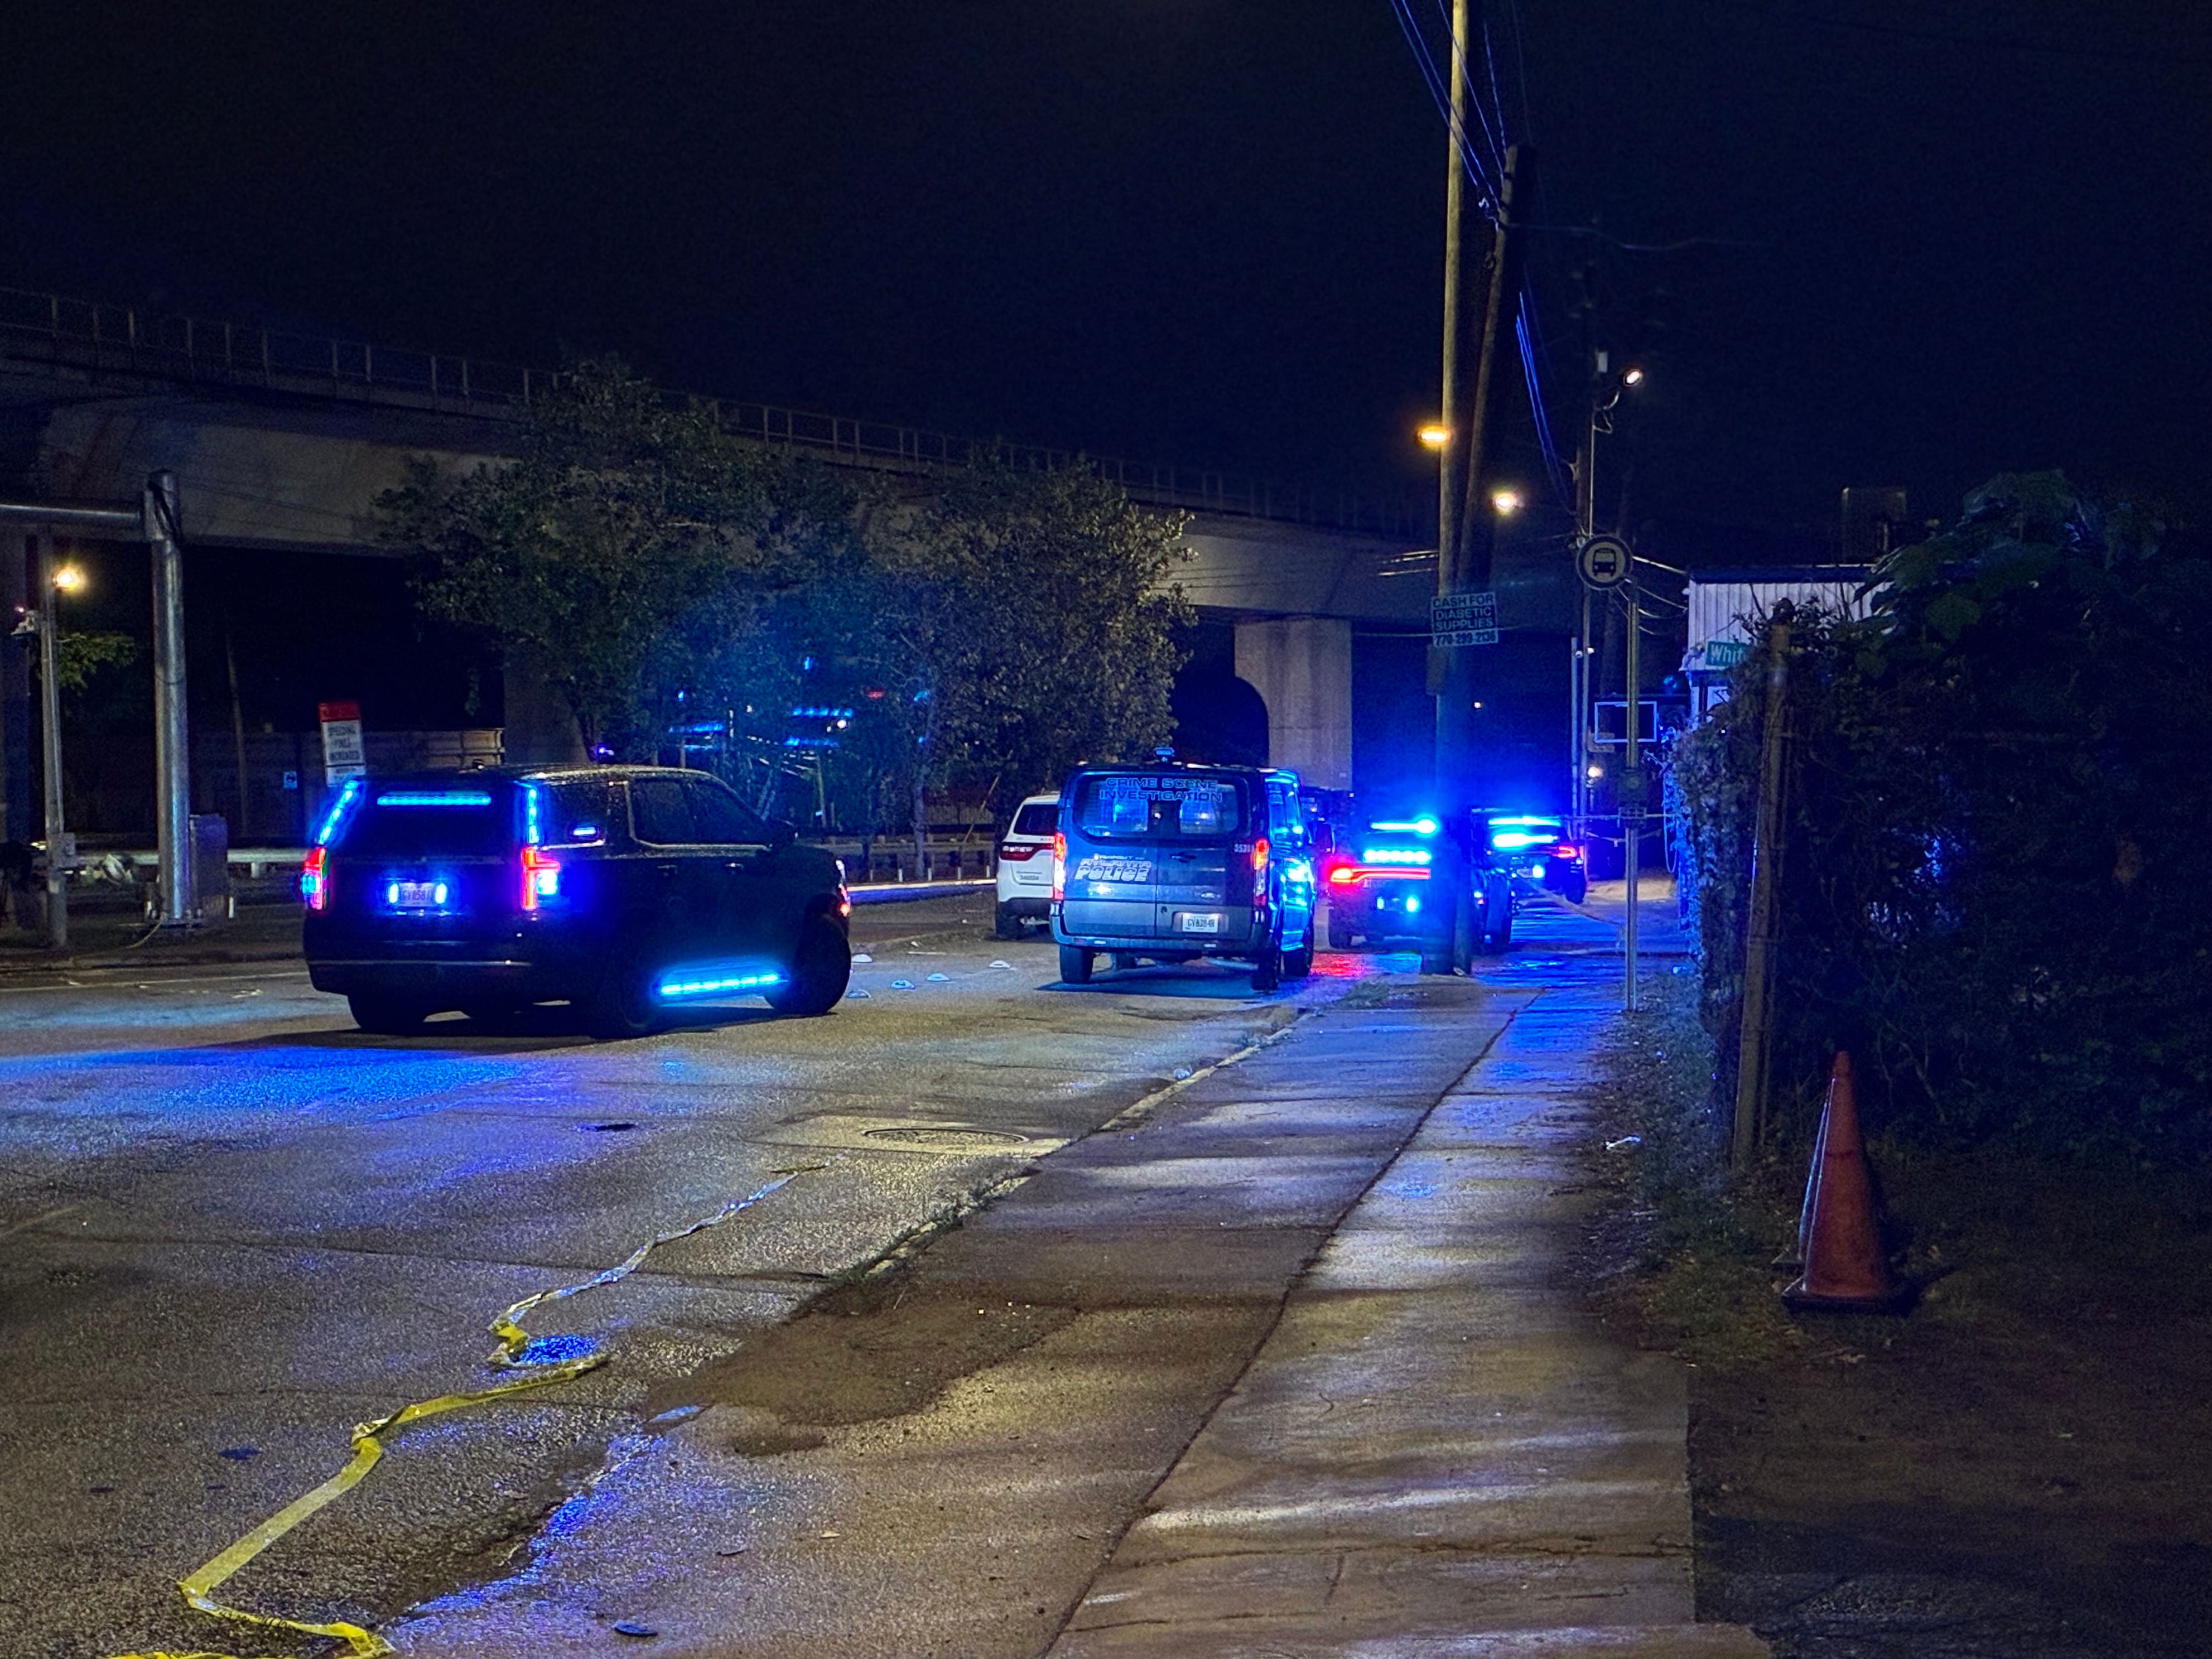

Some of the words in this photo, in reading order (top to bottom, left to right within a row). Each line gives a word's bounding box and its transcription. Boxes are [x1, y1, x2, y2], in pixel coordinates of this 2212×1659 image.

[1433, 597, 1466, 608] CASH
[1469, 594, 1493, 605] FOR
[1435, 606, 1492, 621] DIABETIC
[1435, 617, 1494, 631] SUPPLIES
[1106, 777, 1158, 788] CRIME
[1162, 778, 1218, 790] SCENE
[1099, 789, 1222, 803] INVESTIGATION
[1080, 858, 1152, 869] ATLANTA
[1074, 865, 1151, 882] POLICE
